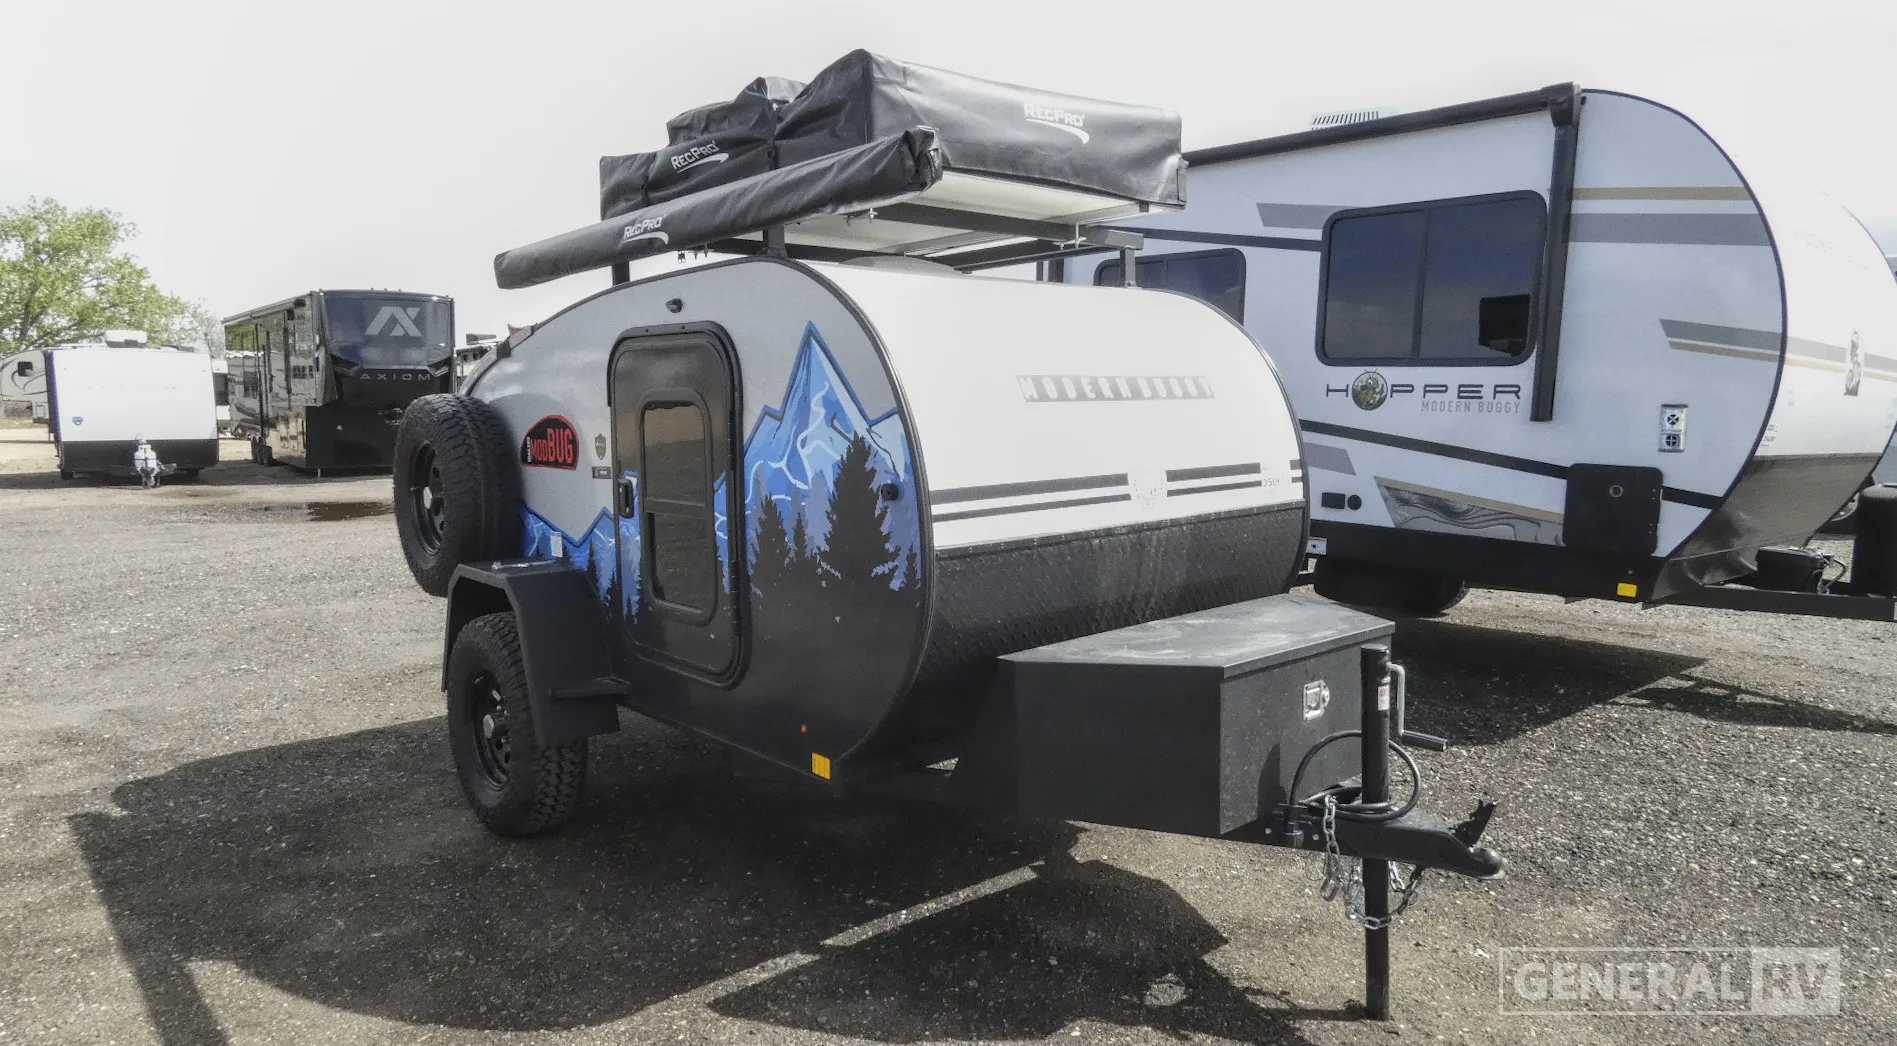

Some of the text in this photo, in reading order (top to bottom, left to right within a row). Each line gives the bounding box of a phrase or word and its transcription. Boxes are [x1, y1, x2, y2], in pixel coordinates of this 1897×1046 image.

[360, 373, 431, 381] AXIOM
[1325, 373, 1521, 410] HOPPER
[1420, 400, 1520, 414] MODERN BUGGY
